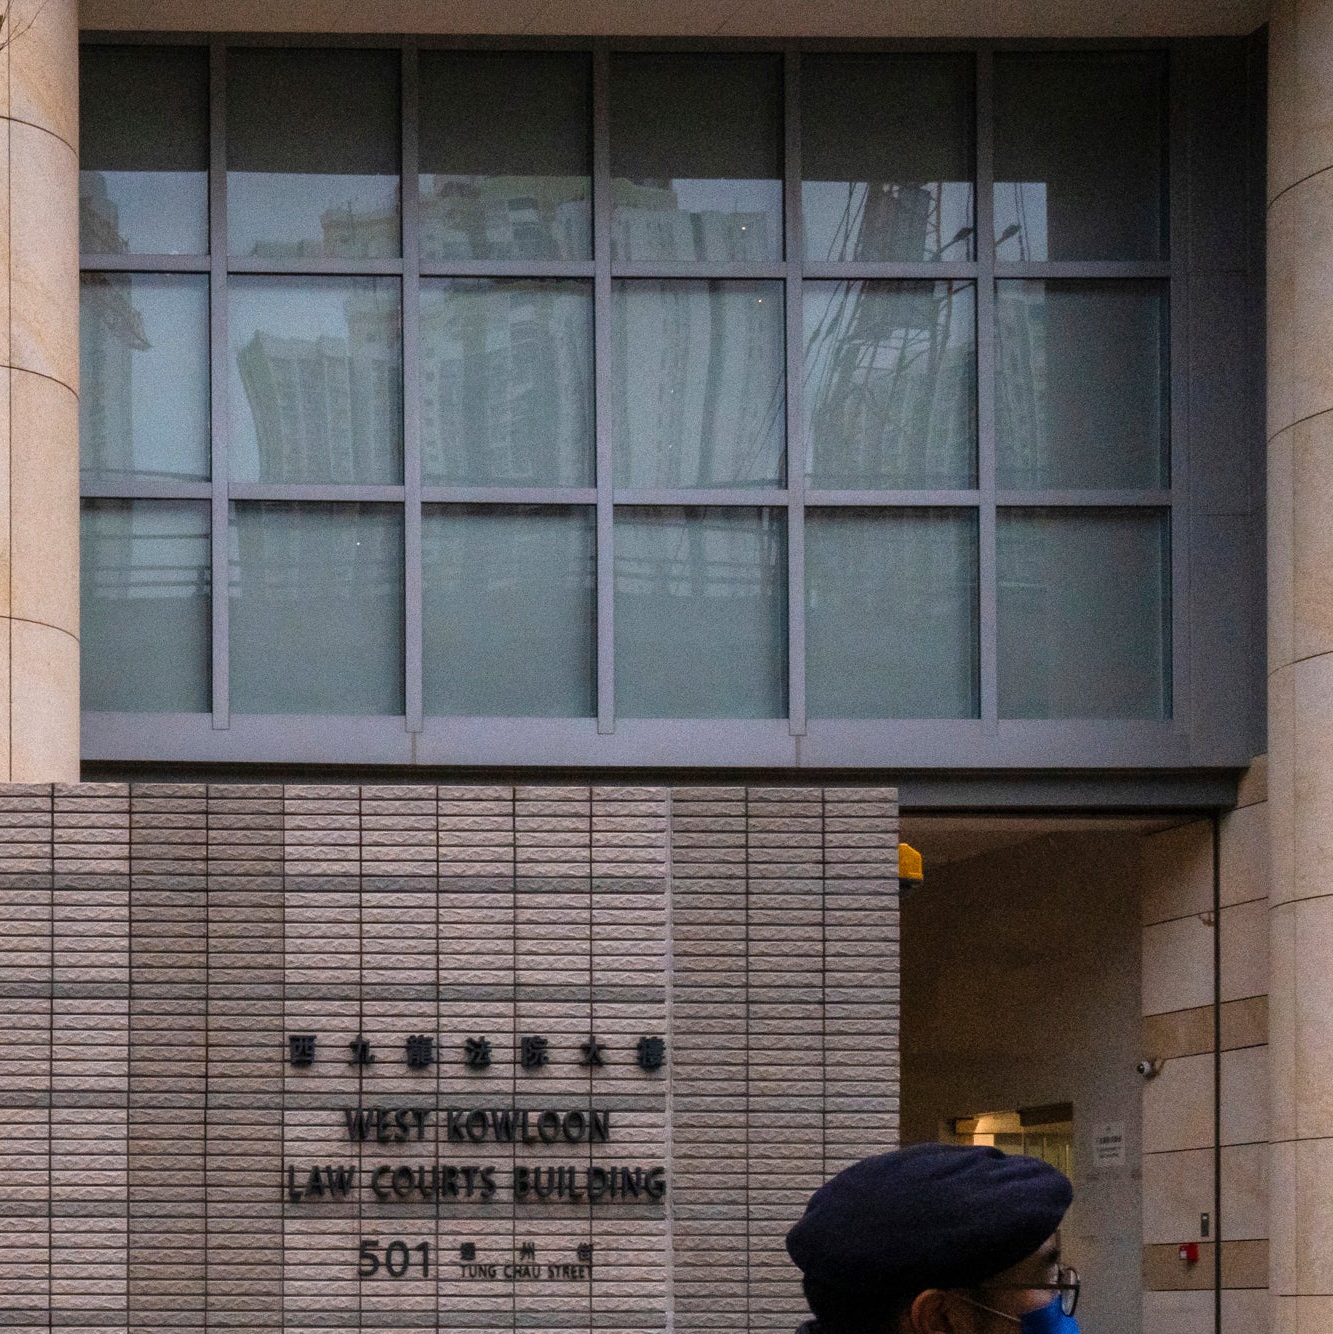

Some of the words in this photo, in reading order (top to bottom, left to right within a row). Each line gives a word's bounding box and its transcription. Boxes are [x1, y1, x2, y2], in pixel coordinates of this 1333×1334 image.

[290, 1034, 667, 1070] 西九龍法院大樓
[345, 1107, 429, 1143] WEST
[446, 1108, 610, 1143] KOWLOON
[287, 1165, 356, 1200] LAW
[371, 1165, 497, 1199] COURTS
[512, 1165, 667, 1199] BUILDING
[357, 1239, 431, 1279] 501
[460, 1265, 496, 1279] TUNG
[504, 1265, 541, 1279] CHAU
[547, 1265, 593, 1279] STREET
